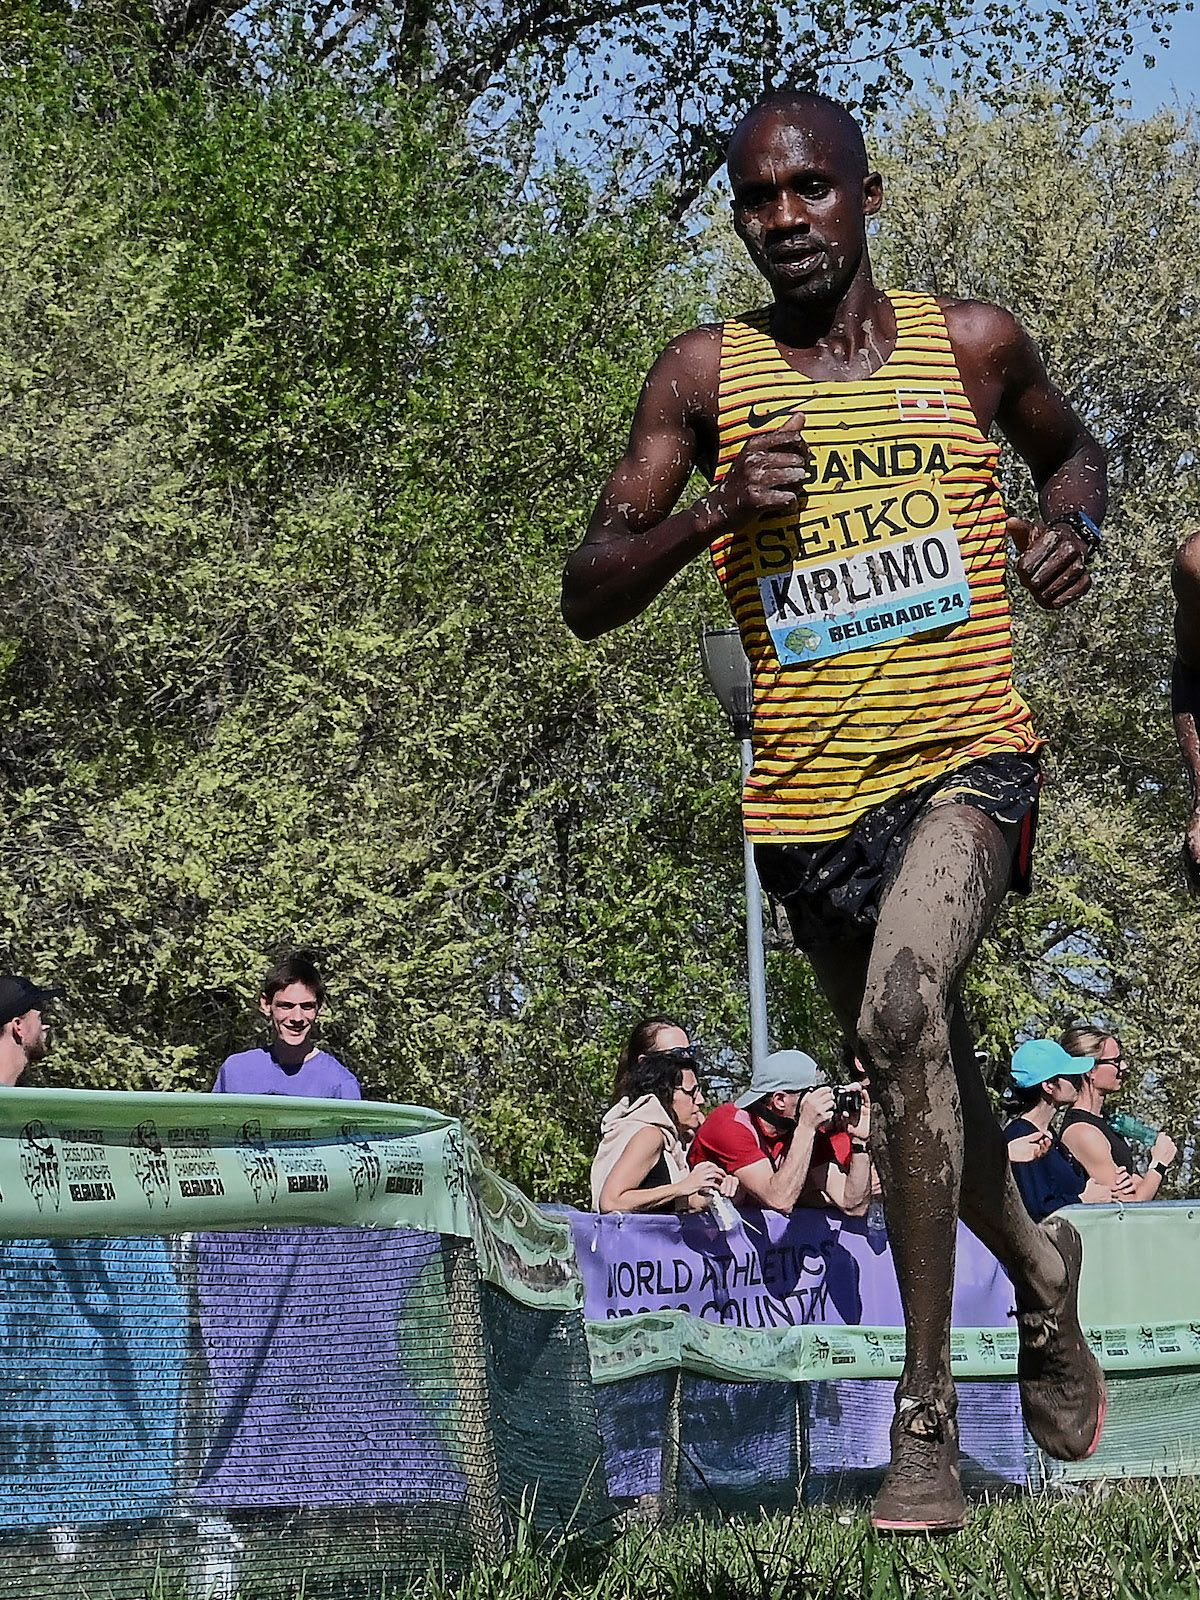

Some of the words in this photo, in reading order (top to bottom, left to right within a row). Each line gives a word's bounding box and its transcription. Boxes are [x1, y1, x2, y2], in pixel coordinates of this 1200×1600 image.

[803, 442, 950, 485] ANDA
[755, 489, 939, 570] SEIKO
[769, 537, 950, 620] KIPLIMO
[828, 598, 935, 643] BELGRADE
[938, 593, 964, 614] 24
